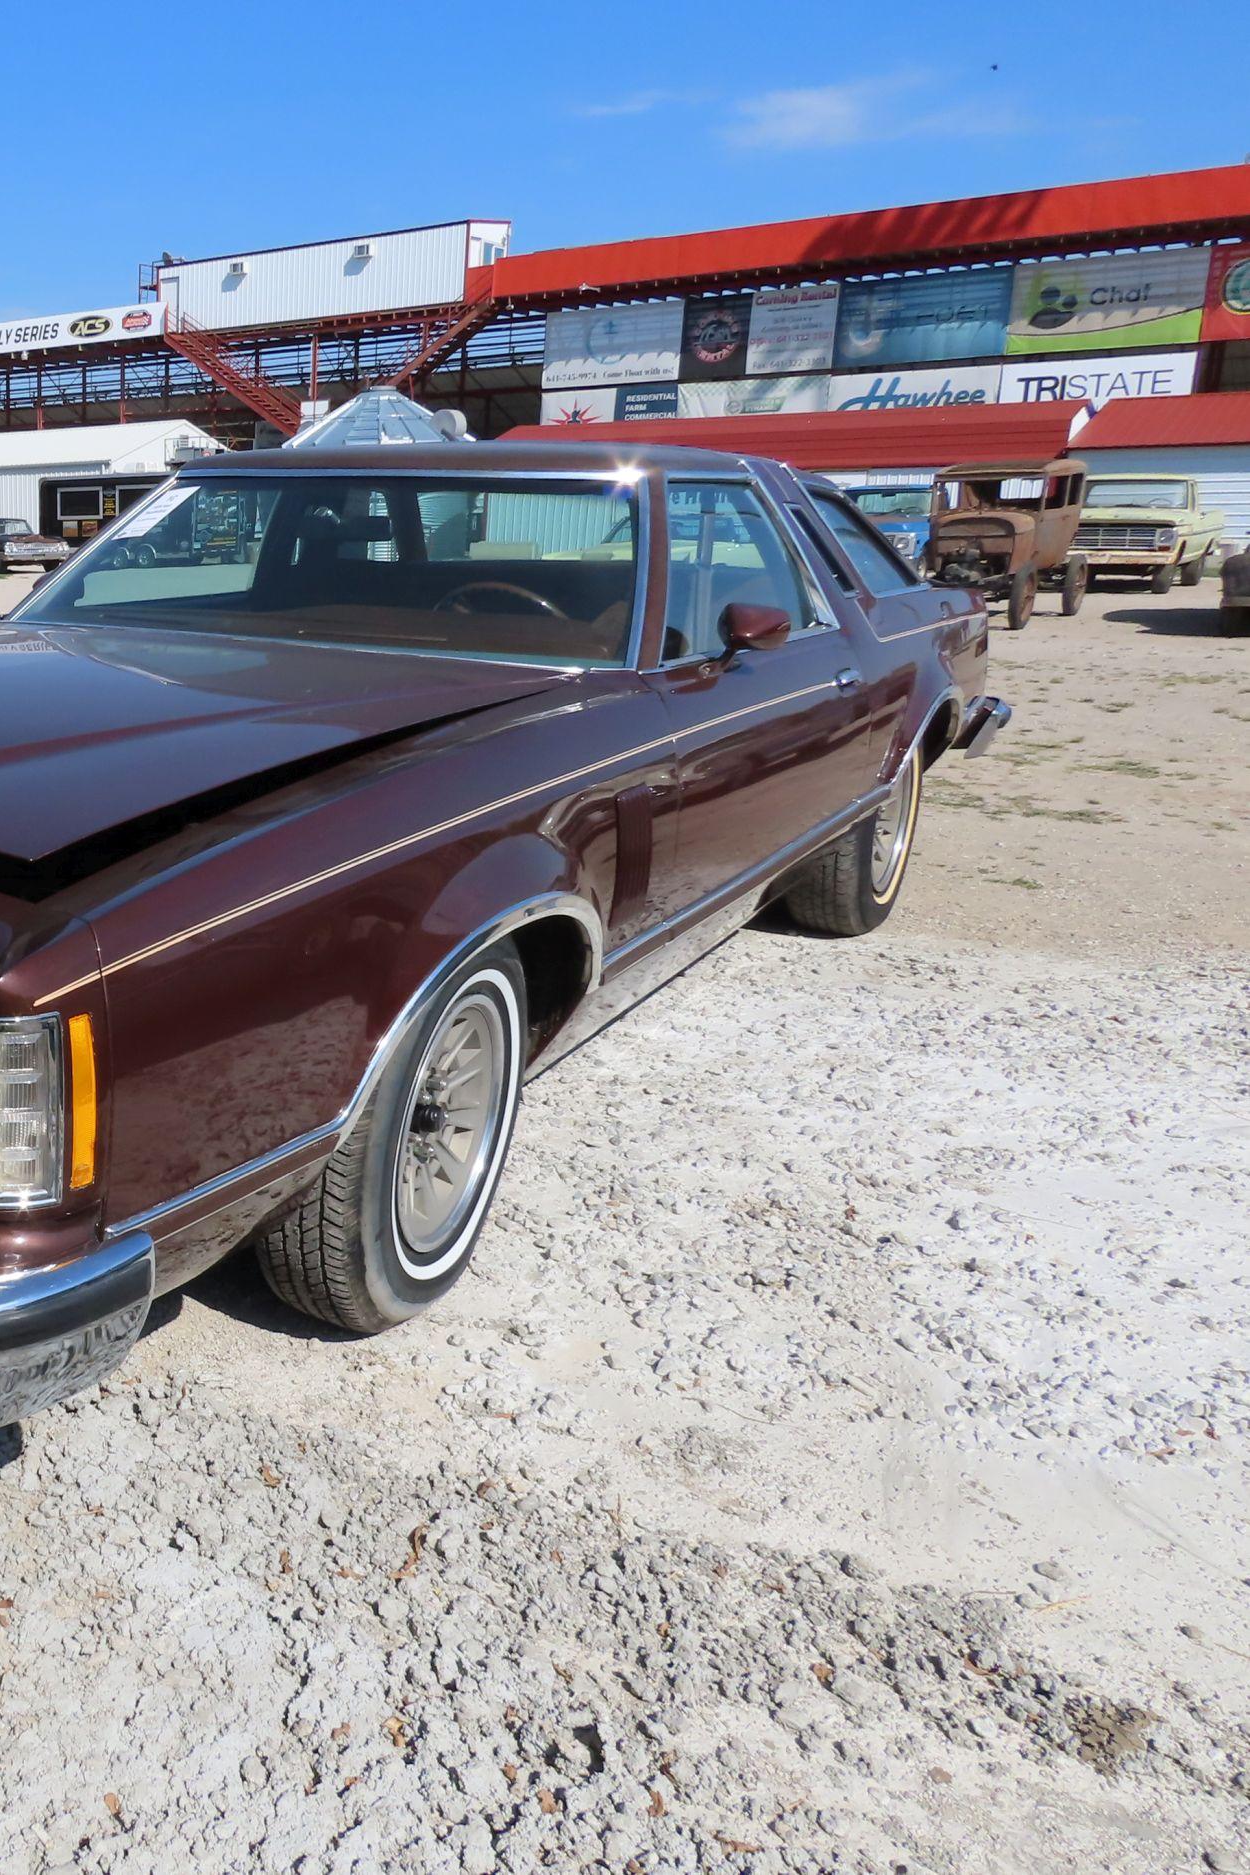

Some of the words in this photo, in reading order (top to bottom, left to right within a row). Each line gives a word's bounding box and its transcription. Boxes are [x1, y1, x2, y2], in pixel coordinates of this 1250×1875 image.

[14, 322, 59, 343] SERIES
[73, 318, 106, 337] ACS
[624, 368, 644, 377] Float
[644, 366, 661, 375] with
[1016, 369, 1174, 403] TRISTATE
[625, 392, 677, 402] RESIDENTIAL
[625, 403, 647, 412] FARM
[624, 412, 677, 421] COMMERCIAL
